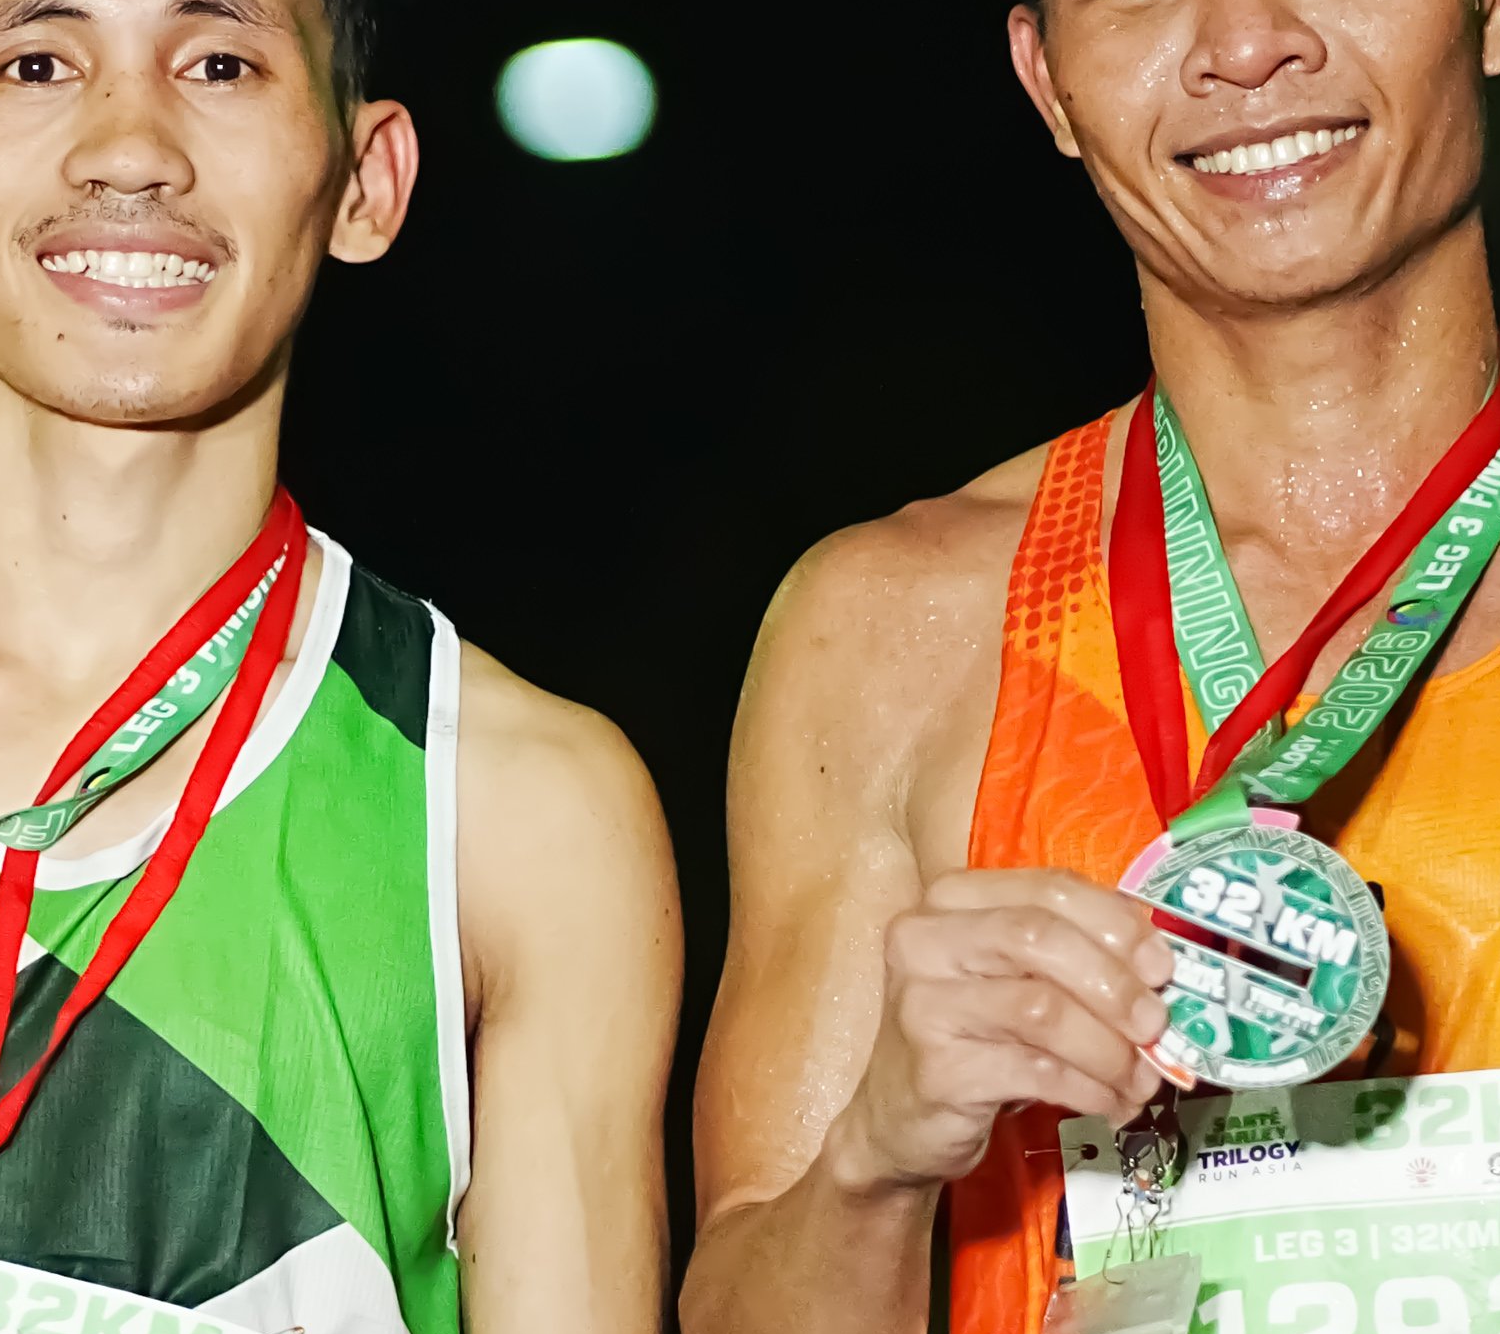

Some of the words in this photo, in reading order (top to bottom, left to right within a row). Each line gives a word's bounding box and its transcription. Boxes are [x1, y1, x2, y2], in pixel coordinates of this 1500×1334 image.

[1416, 544, 1470, 591] LEG
[1448, 515, 1483, 537] 3
[111, 698, 178, 754] LEG
[167, 666, 202, 695] 3
[1304, 631, 1431, 732] 2026
[1181, 866, 1262, 929] 32
[1271, 906, 1359, 967] KM
[1196, 1139, 1301, 1169] TRILOGY
[1199, 1170, 1238, 1183] RUN
[1252, 1162, 1302, 1176] ASIA
[1254, 1230, 1324, 1262] LEG
[1336, 1228, 1358, 1255] 3
[1390, 1219, 1498, 1254] 32KM
